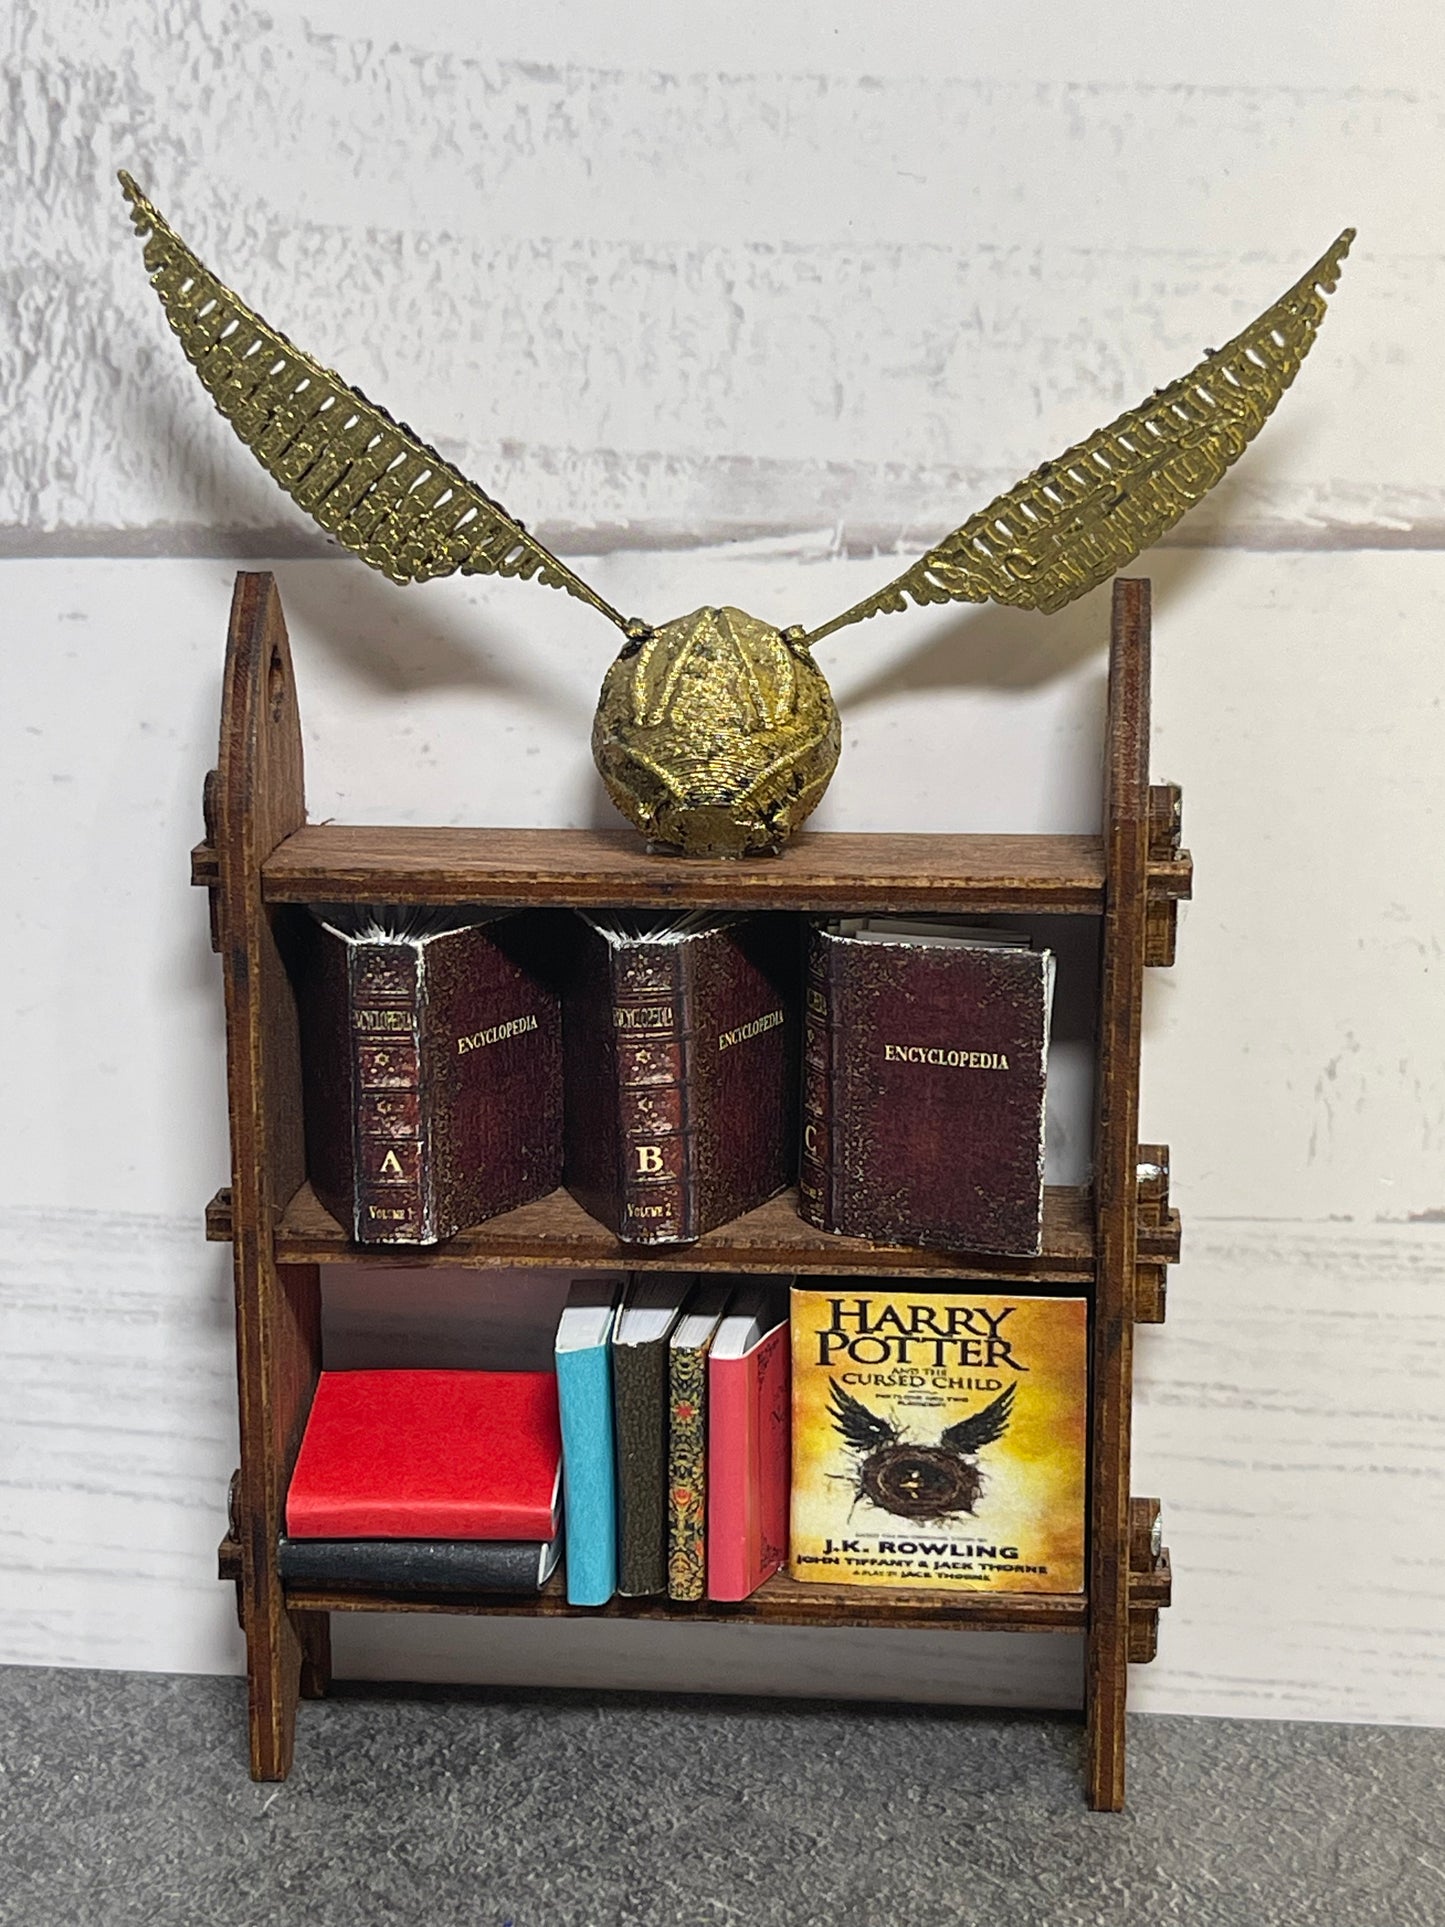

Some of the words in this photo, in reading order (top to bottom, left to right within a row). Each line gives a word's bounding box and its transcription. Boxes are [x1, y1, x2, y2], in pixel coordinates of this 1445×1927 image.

[457, 1014, 539, 1055] ENCYCLOPEDIA
[718, 1009, 785, 1051] ENCYCLOPEDIA
[884, 1044, 1010, 1070] ENCYCLOPEDIA
[379, 1149, 404, 1173] A
[635, 1146, 664, 1173] B
[665, 1202, 673, 1217] 2
[826, 1298, 1017, 1341] HARRY
[815, 1331, 1030, 1371] POTTER
[842, 1372, 926, 1388] CURSED
[932, 1376, 1003, 1391] CHILD
[921, 1367, 947, 1376] THE
[822, 1539, 870, 1555] J.K.
[879, 1541, 1019, 1560] ROWLING
[797, 1554, 840, 1566] JOHN
[844, 1556, 914, 1568] TIFFANY
[933, 1560, 974, 1572] JACK
[978, 1562, 1049, 1575] THORNE
